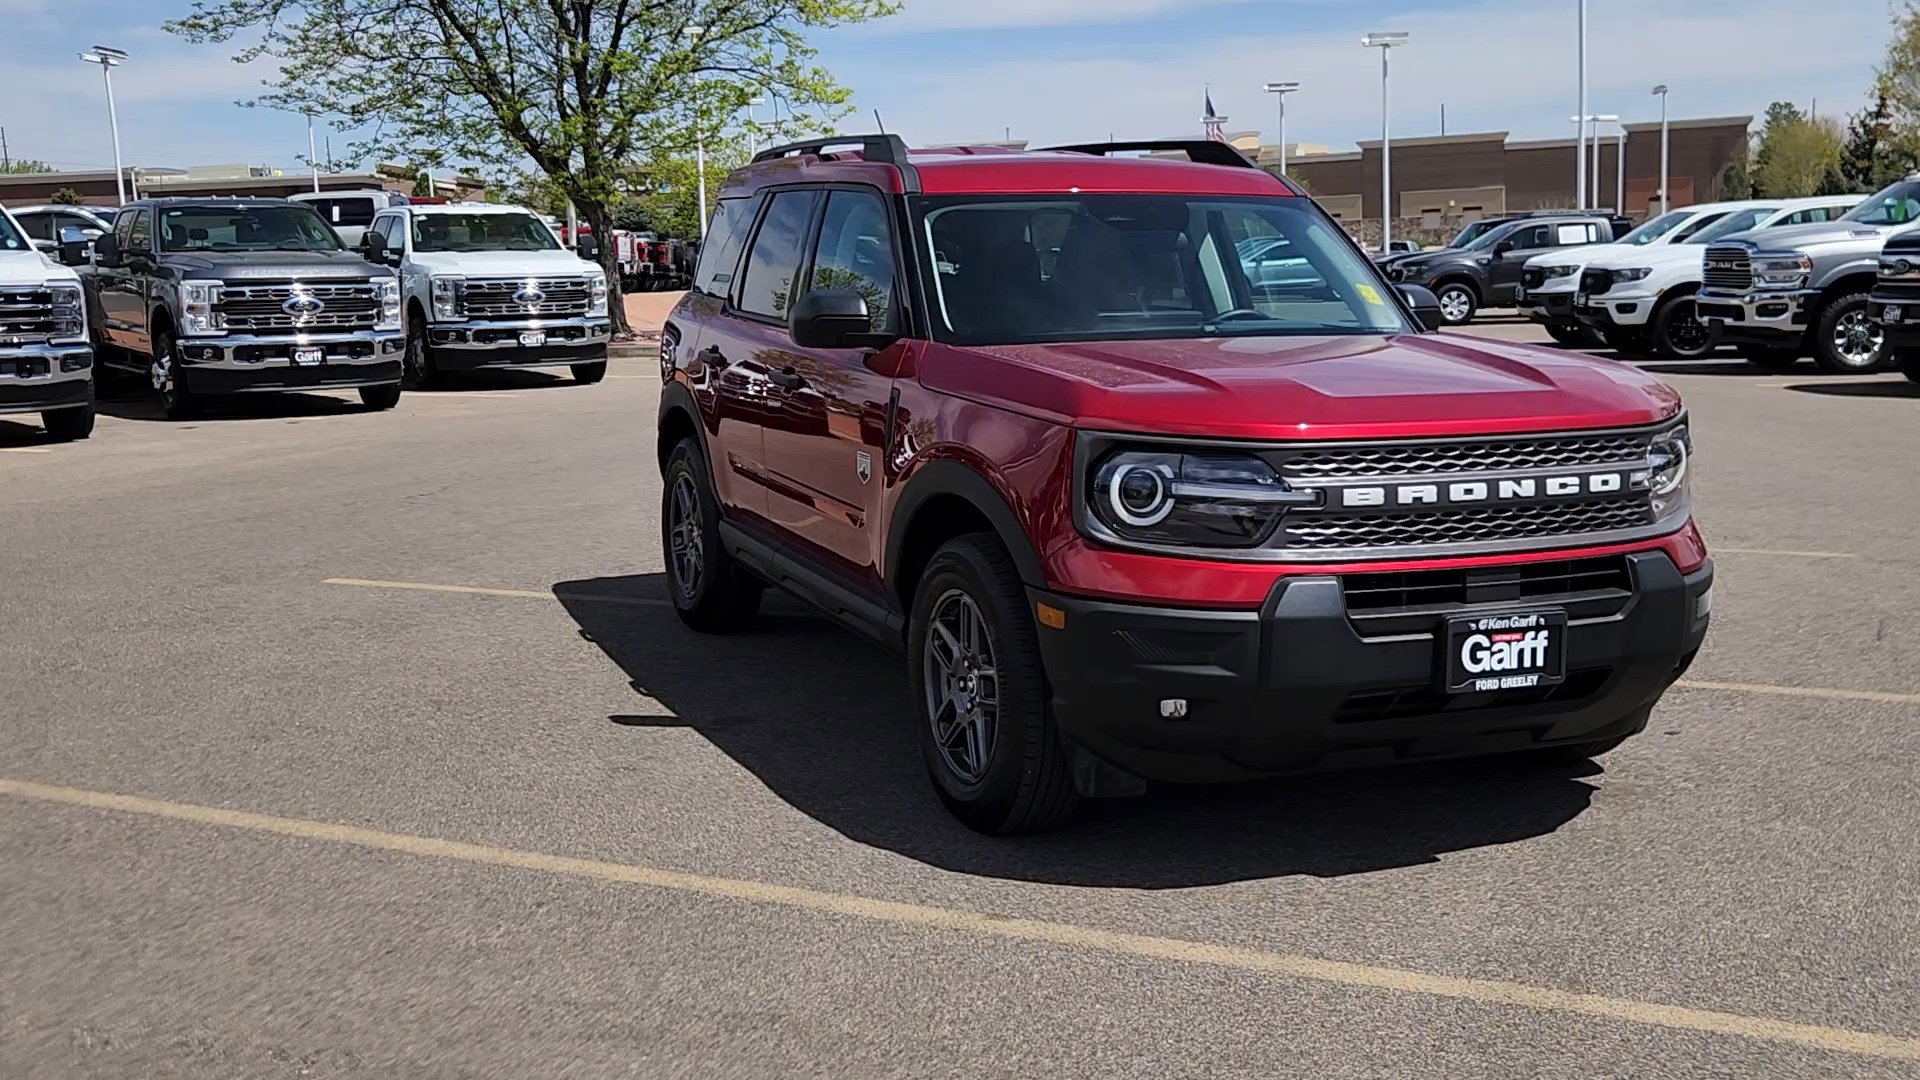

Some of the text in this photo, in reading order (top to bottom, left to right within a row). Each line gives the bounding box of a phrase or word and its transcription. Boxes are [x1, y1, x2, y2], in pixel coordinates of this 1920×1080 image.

[1708, 261, 1732, 269] RAM
[294, 350, 323, 363] Garff
[1342, 473, 1621, 507] BRONCO
[1487, 614, 1538, 630] Ken Garff
[1461, 629, 1549, 674] Garff
[1475, 675, 1539, 691] FORD GREELEY
